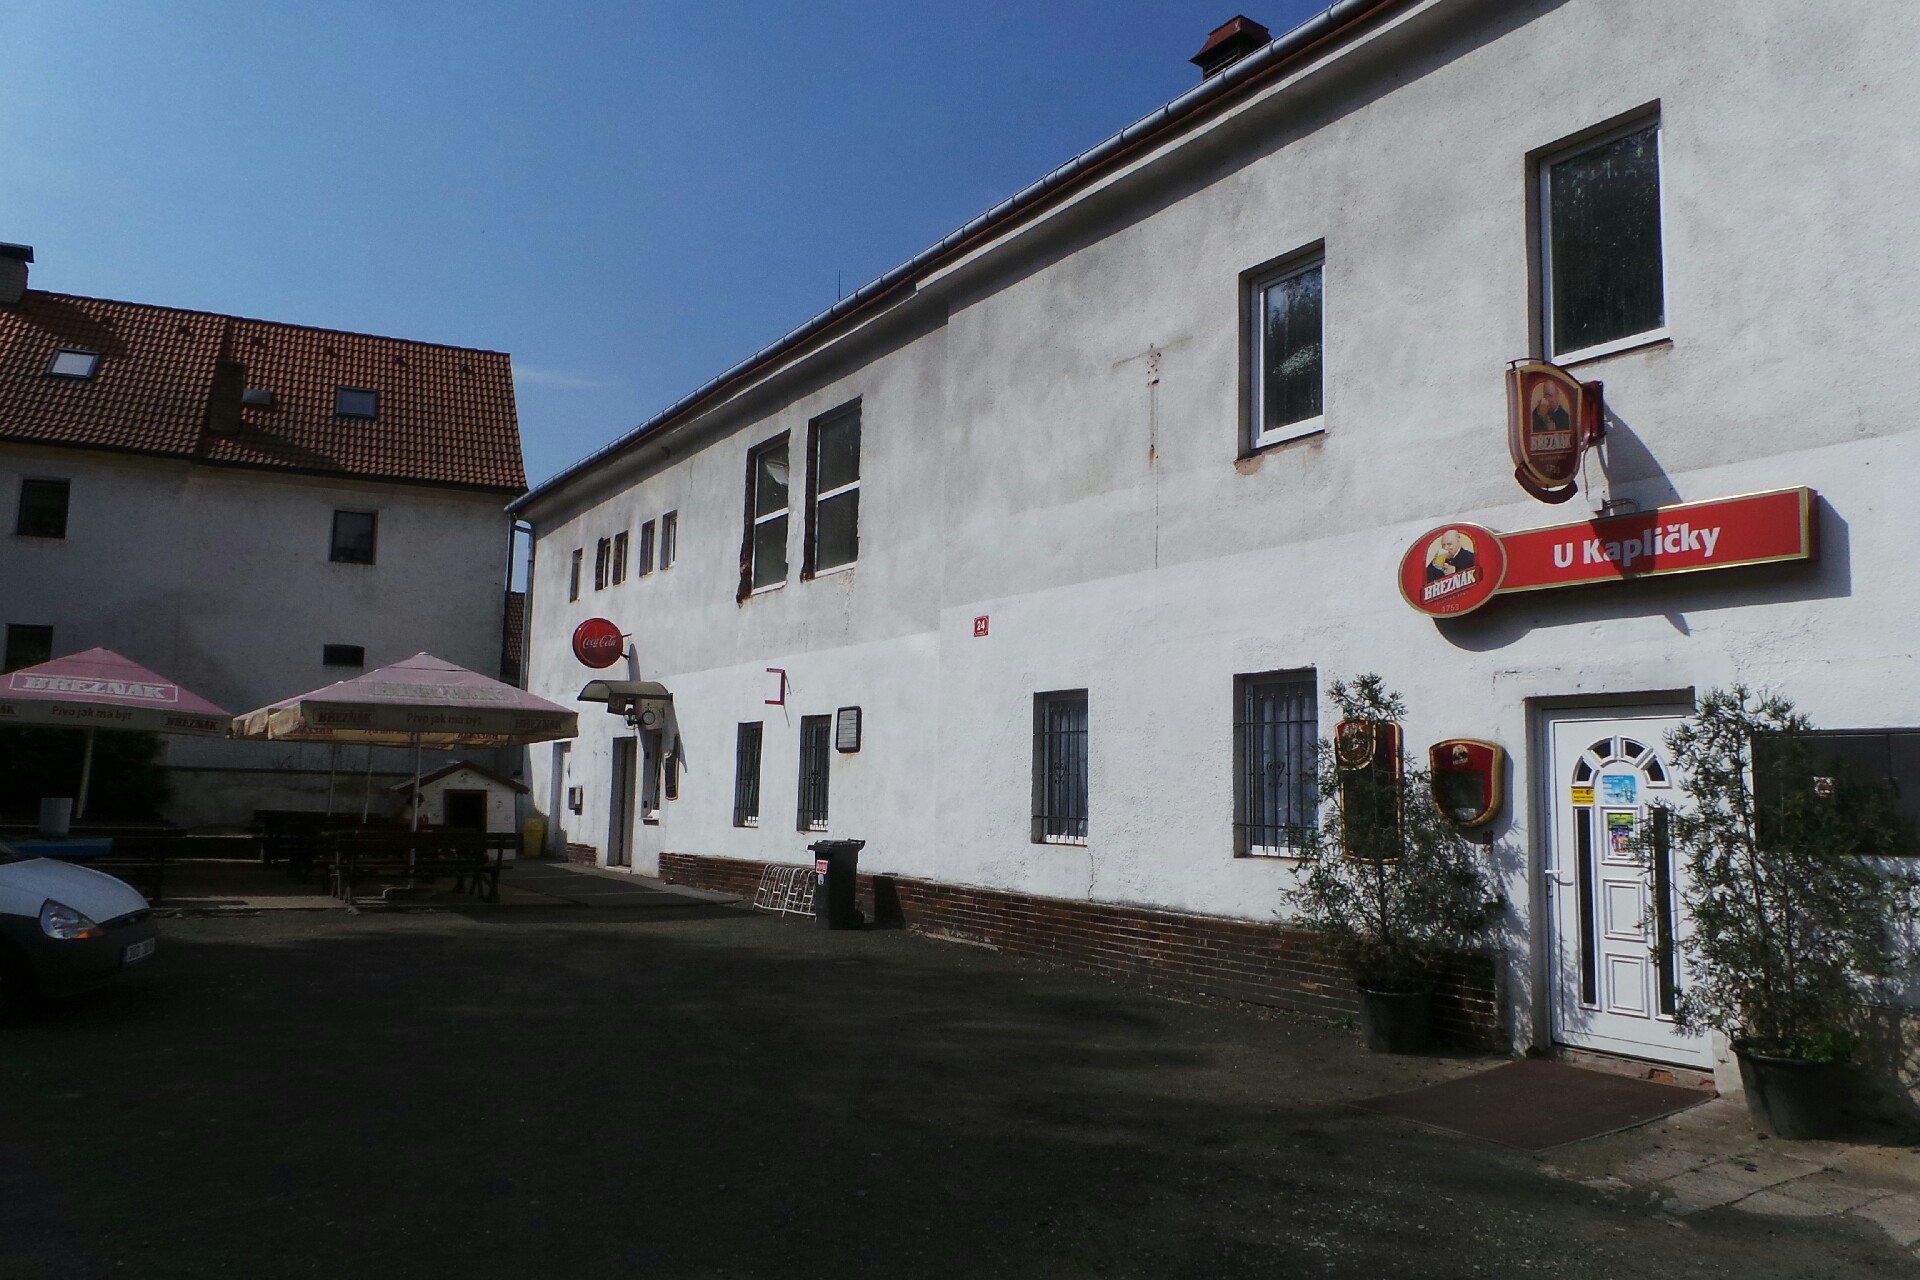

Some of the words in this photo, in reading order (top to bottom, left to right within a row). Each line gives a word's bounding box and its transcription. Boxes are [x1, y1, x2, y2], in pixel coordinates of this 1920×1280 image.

[1553, 542, 1574, 568] U
[1583, 522, 1721, 567] Kapličky
[1442, 603, 1460, 613] 1753
[976, 619, 986, 631] 24
[52, 705, 76, 717] Pivo
